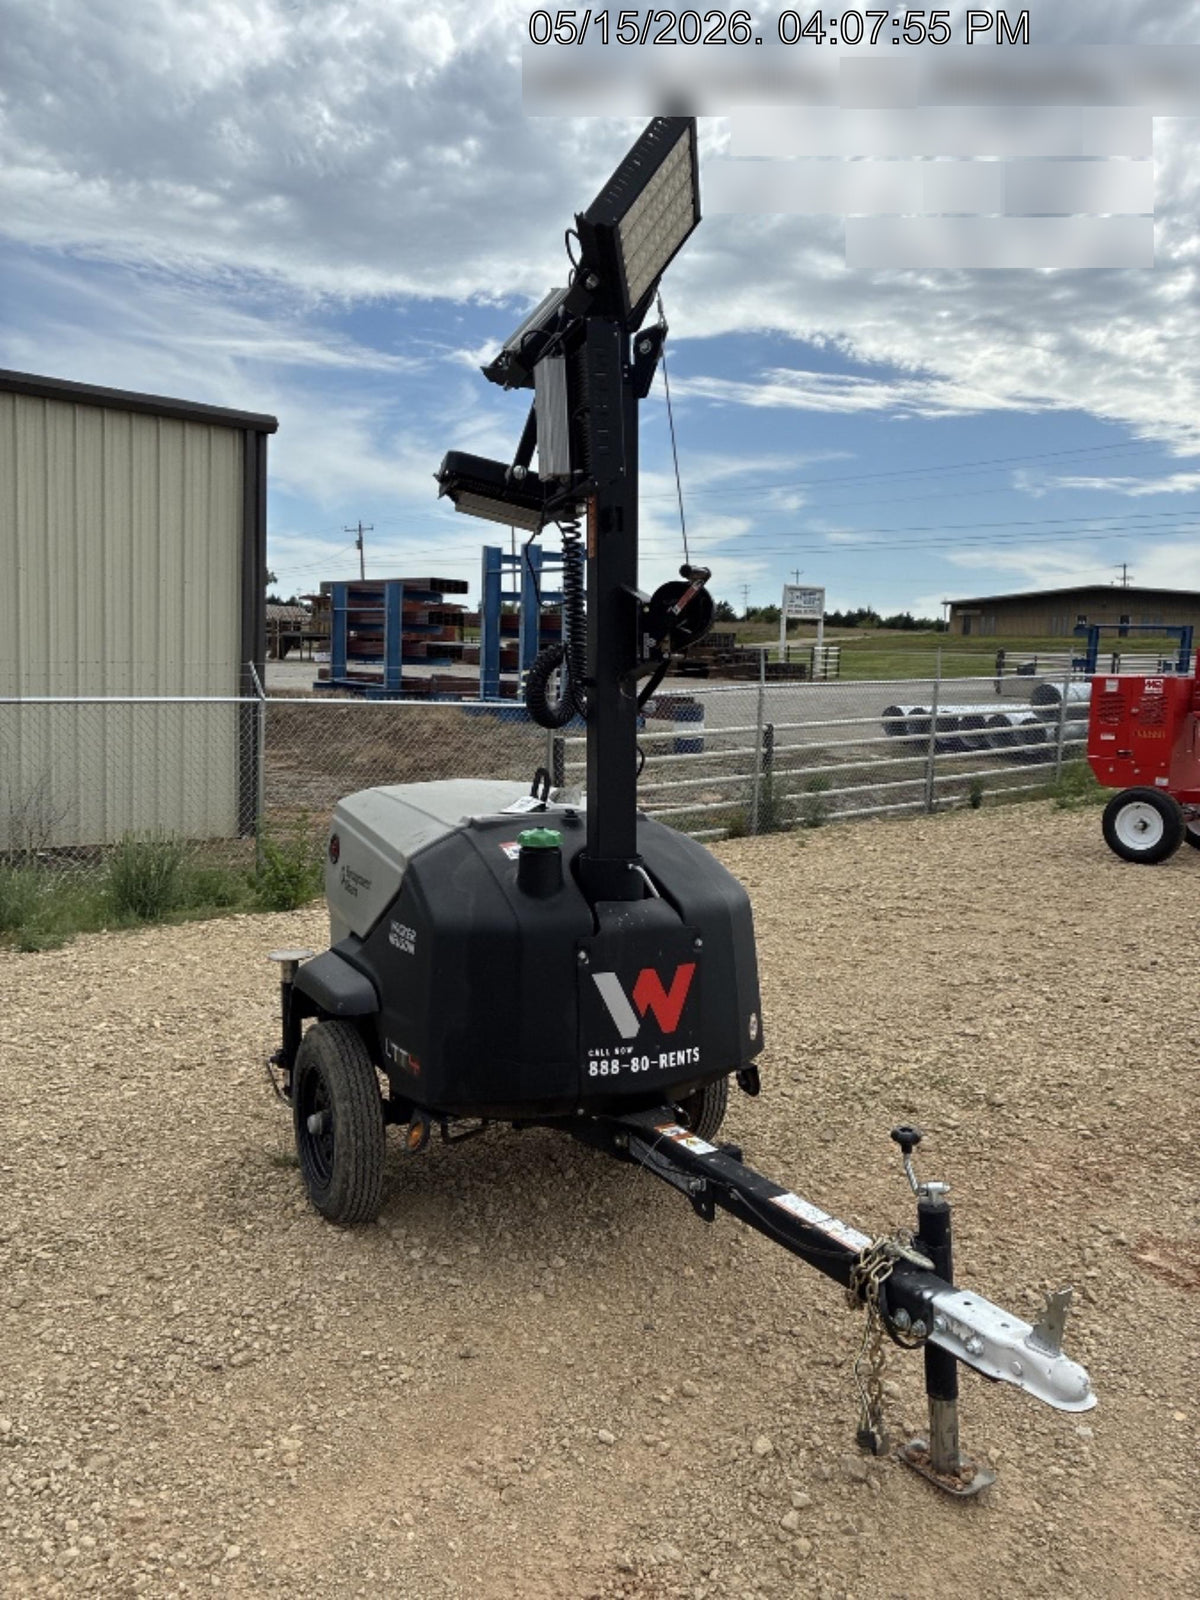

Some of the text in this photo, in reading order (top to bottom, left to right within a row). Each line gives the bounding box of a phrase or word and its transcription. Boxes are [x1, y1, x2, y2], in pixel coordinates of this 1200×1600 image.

[588, 1046, 634, 1057] CALL NOW
[589, 1047, 700, 1076] 888-80-RENTS
